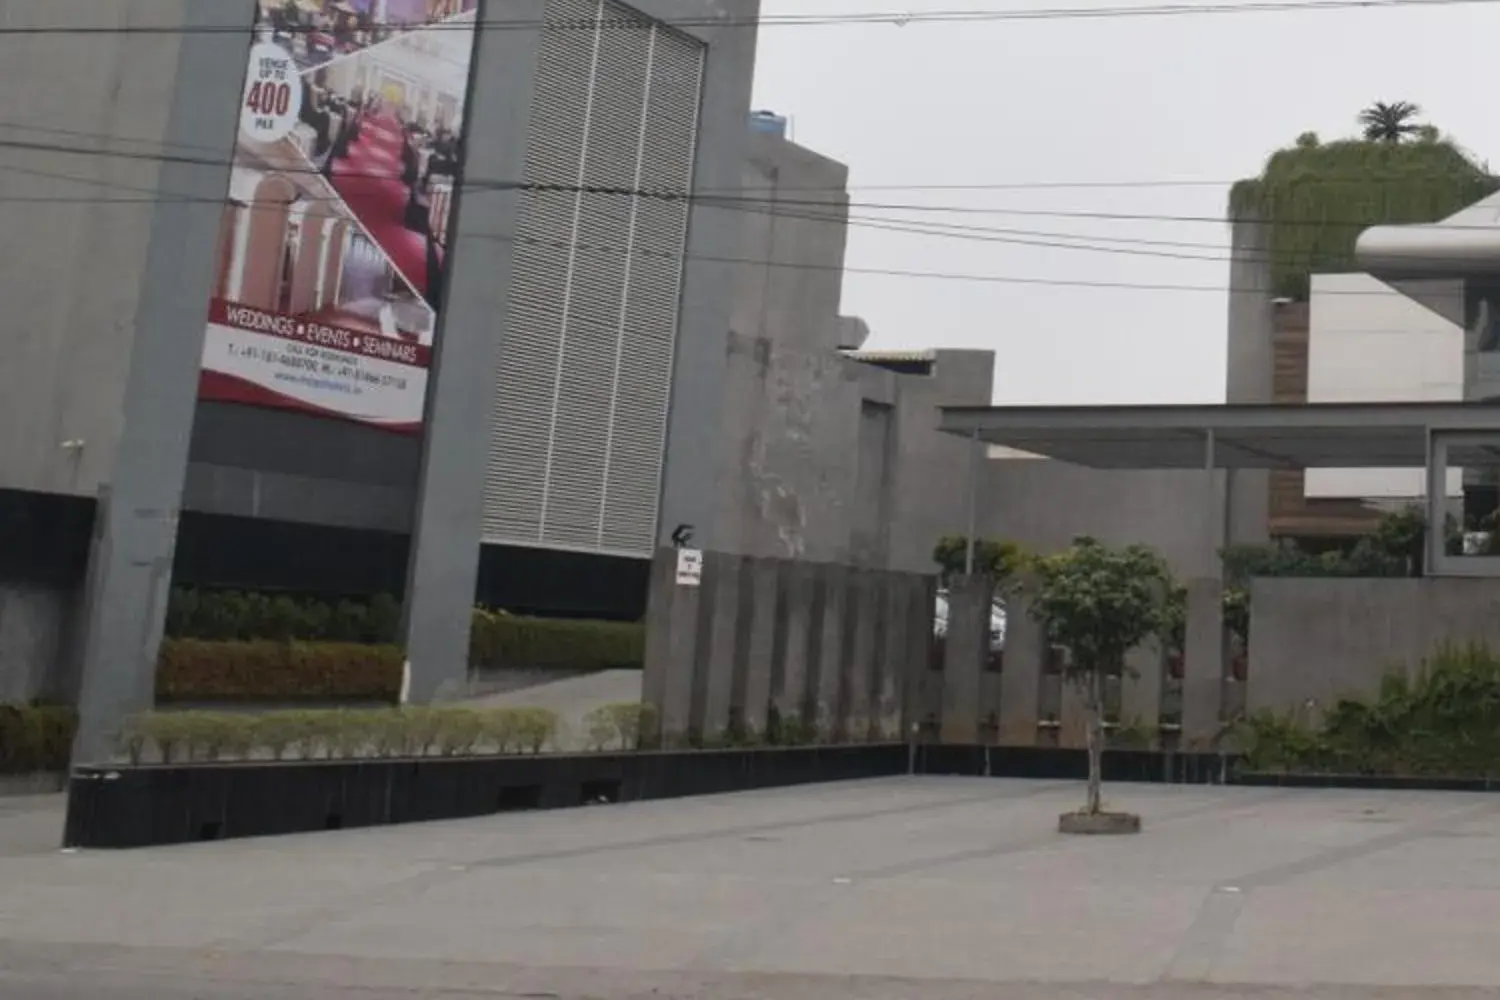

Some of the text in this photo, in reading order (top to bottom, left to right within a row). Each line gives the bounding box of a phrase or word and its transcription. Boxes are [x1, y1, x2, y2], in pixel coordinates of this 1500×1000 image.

[247, 81, 291, 117] 400
[226, 305, 295, 337] WEDDINGS
[306, 322, 350, 349] EVENTS
[362, 335, 417, 363] SEMINARS
